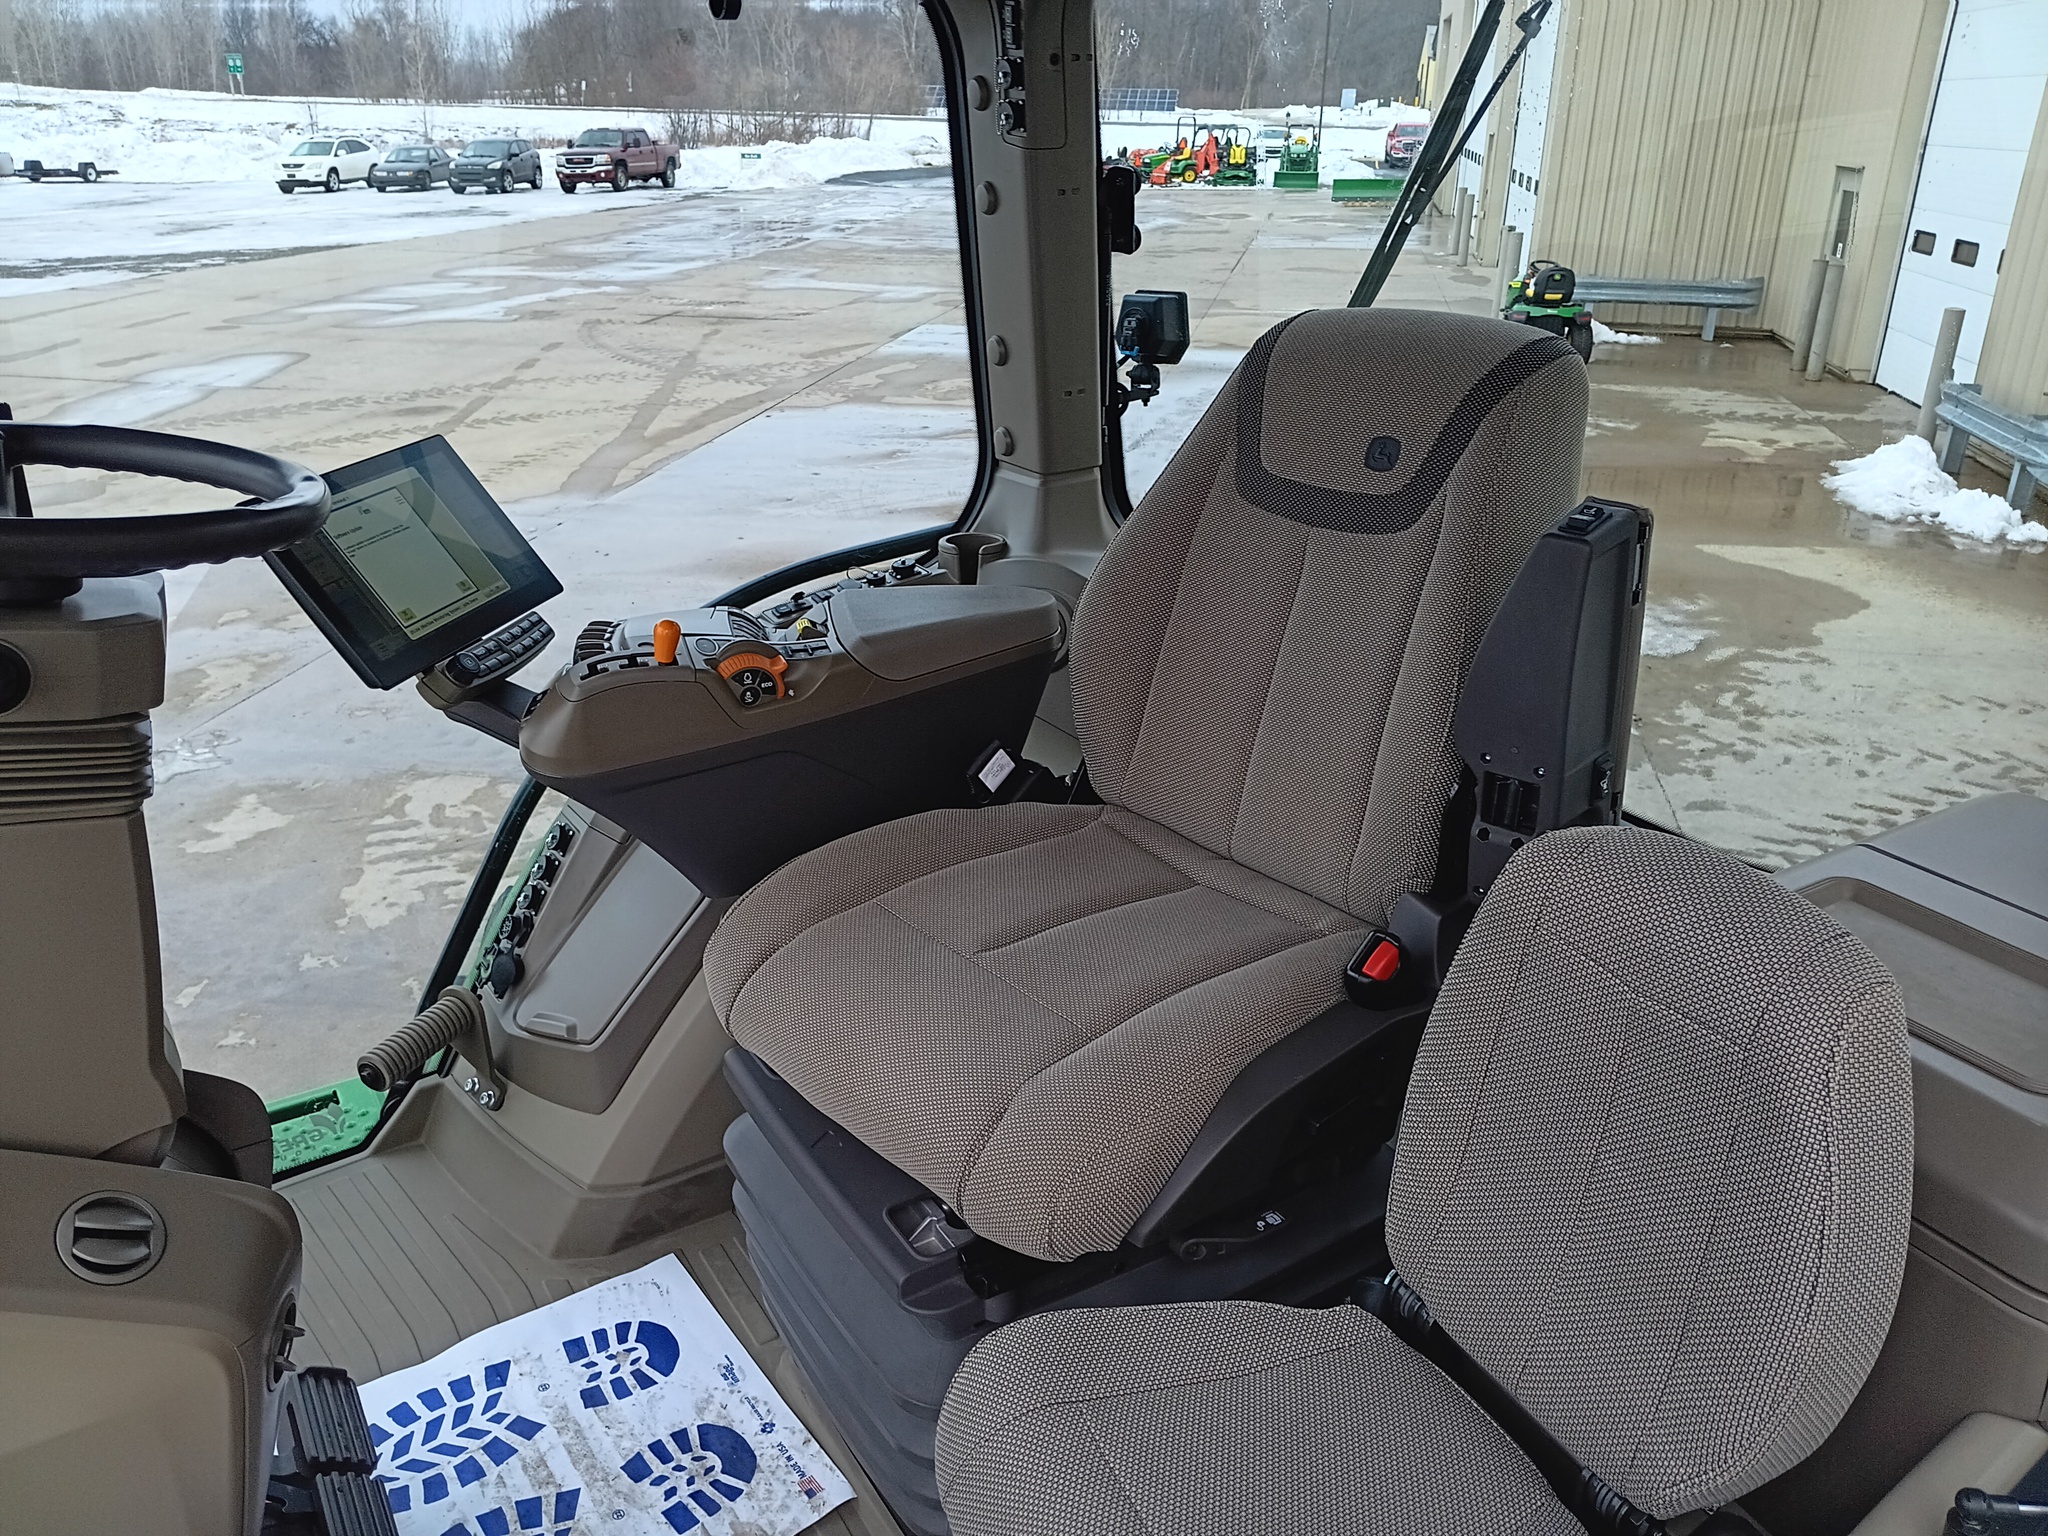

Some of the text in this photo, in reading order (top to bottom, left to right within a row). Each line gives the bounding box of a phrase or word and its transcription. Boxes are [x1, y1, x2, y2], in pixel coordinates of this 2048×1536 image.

[776, 1441, 807, 1480] MADE IN USA
